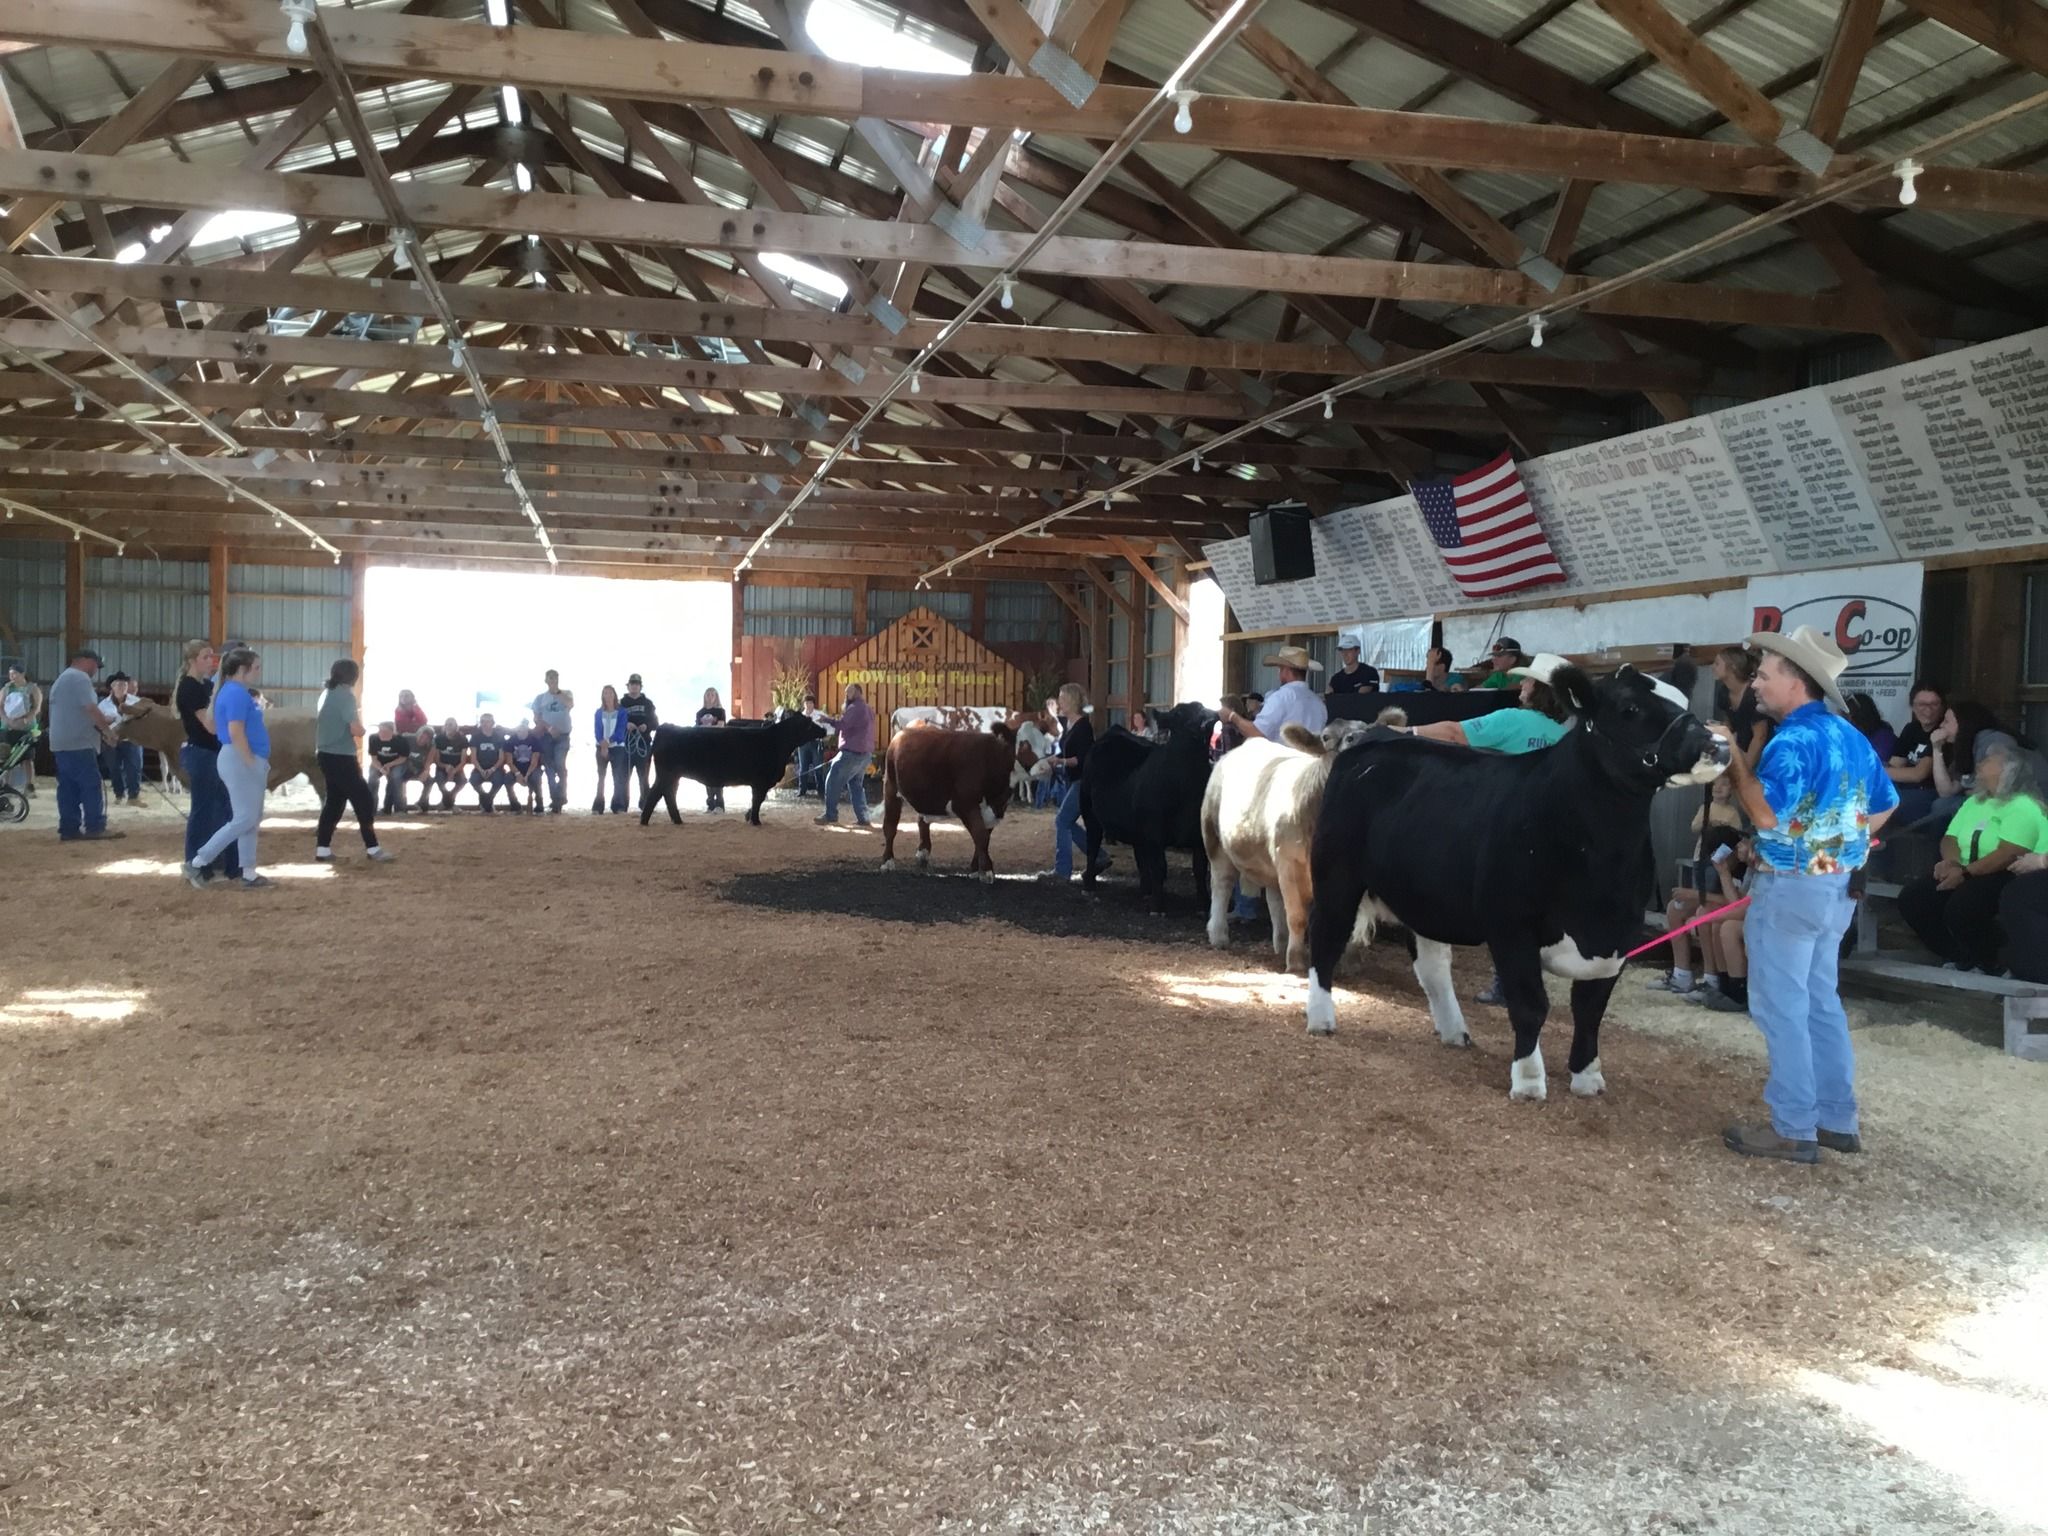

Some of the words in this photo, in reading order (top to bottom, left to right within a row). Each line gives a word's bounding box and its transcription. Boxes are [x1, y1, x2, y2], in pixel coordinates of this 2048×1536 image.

[1626, 458, 1648, 477] our
[934, 661, 977, 671] COUNTY
[916, 670, 944, 684] Our
[950, 670, 1004, 684] Future
